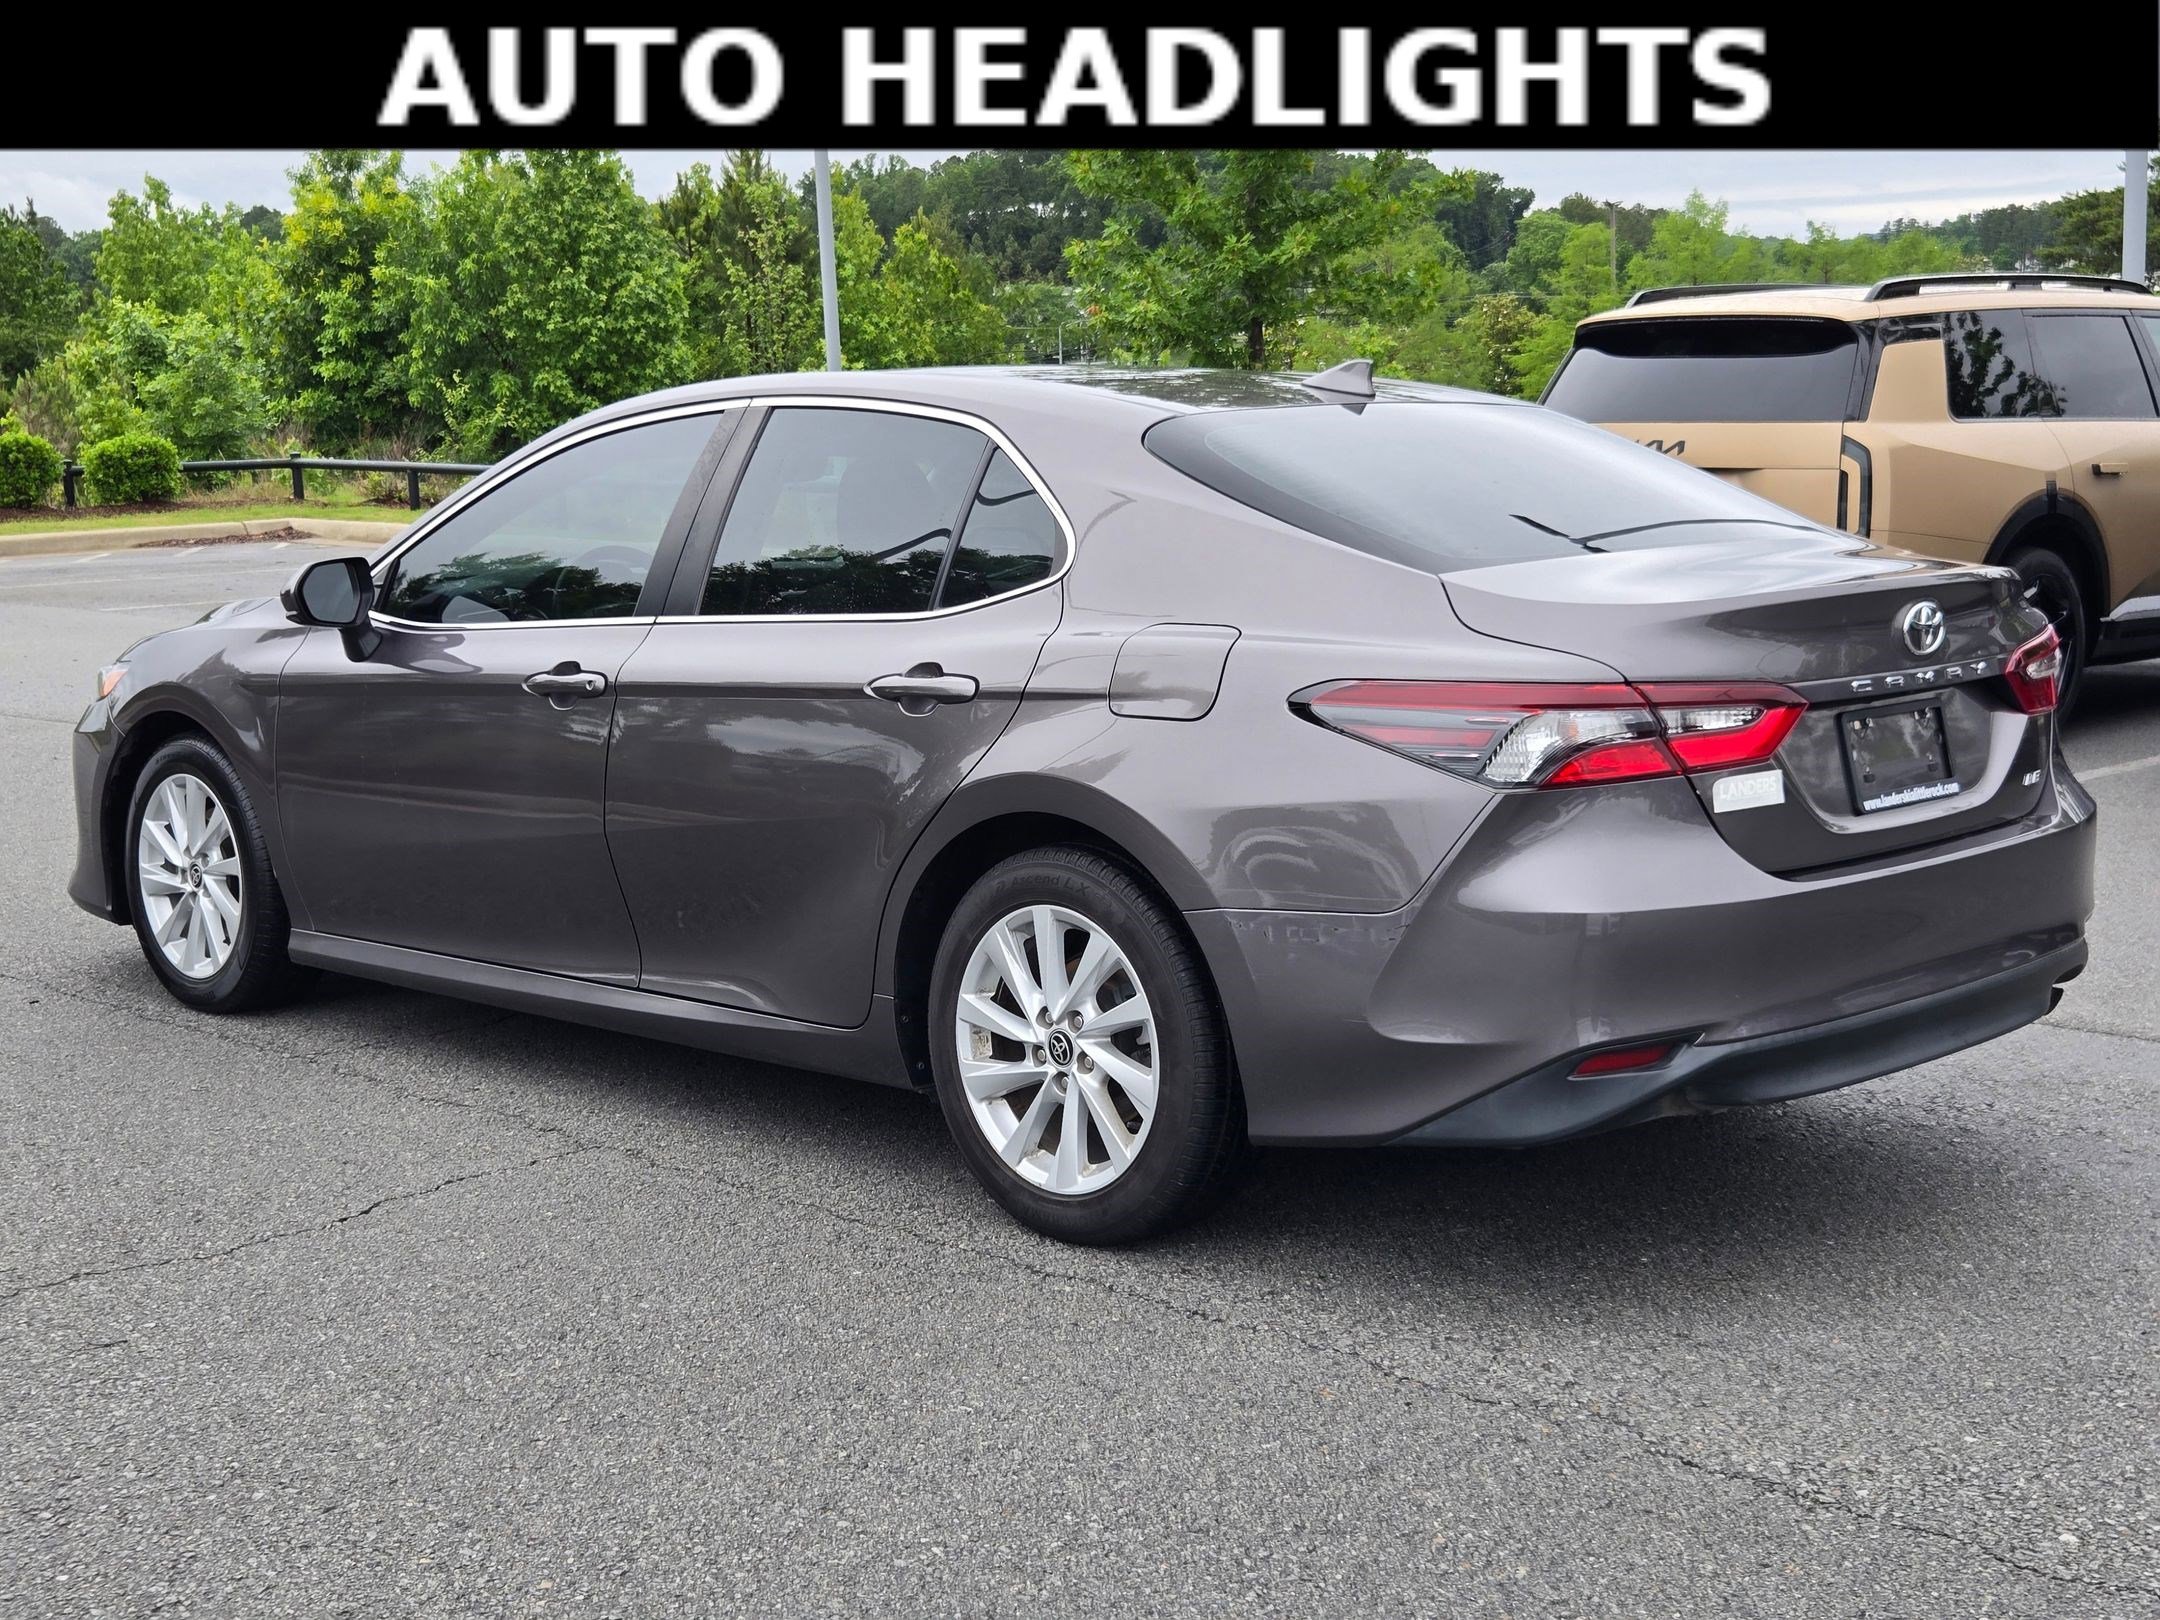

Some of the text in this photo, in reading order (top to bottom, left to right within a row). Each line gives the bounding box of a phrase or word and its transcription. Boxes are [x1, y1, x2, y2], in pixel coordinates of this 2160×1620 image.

[1851, 661, 1987, 692] CAMRY
[1719, 775, 1777, 800] LANDERS
[1012, 874, 1060, 890] Ascend
